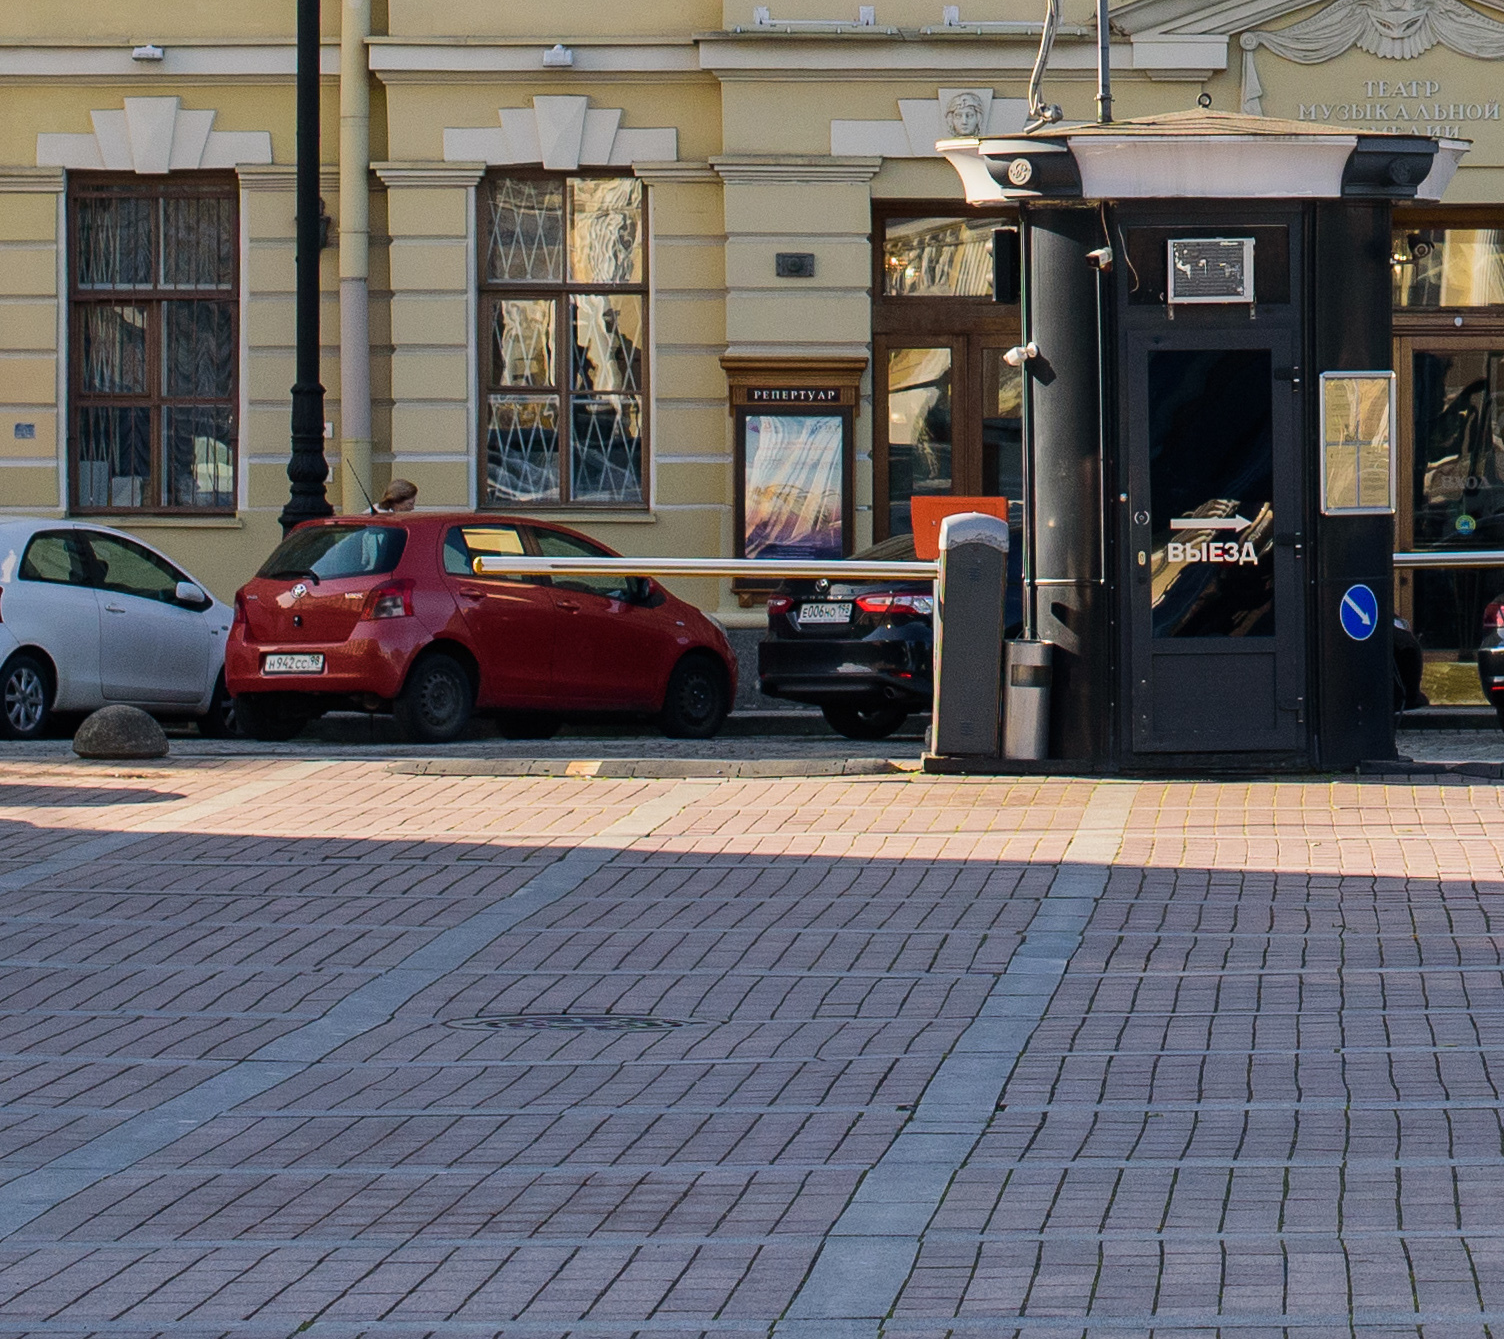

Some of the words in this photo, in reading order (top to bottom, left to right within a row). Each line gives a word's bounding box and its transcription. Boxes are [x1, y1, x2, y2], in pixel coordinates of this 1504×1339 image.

[1363, 80, 1439, 98] ТЕАТР
[1297, 100, 1501, 121] МУЗЫКАЛЬНОЙ
[753, 390, 835, 401] РЕПЕРТУАР
[1167, 542, 1259, 566] ВЫЕЗД
